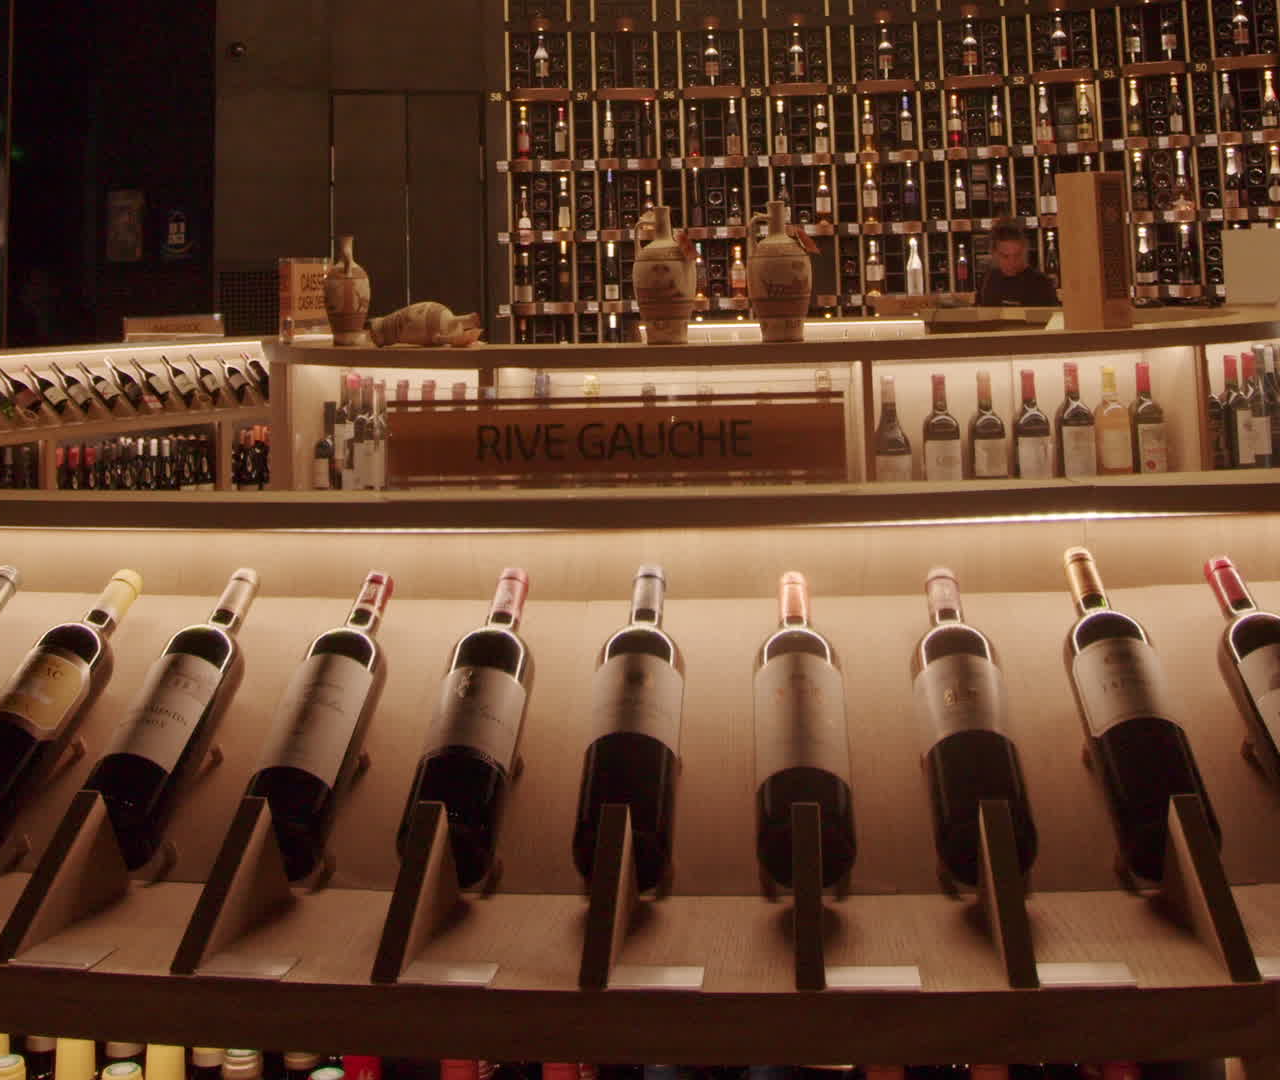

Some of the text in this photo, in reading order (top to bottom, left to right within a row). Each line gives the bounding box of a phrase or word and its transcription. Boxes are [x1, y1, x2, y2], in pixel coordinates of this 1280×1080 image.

[1195, 63, 1207, 73] 50
[1103, 70, 1114, 79] 51
[1013, 76, 1025, 85] 52
[836, 85, 848, 94] 54
[924, 81, 936, 90] 53
[577, 92, 588, 101] 57
[663, 90, 675, 99] 56
[750, 88, 762, 97] 55
[475, 419, 753, 463] RIVE GAUCHE
